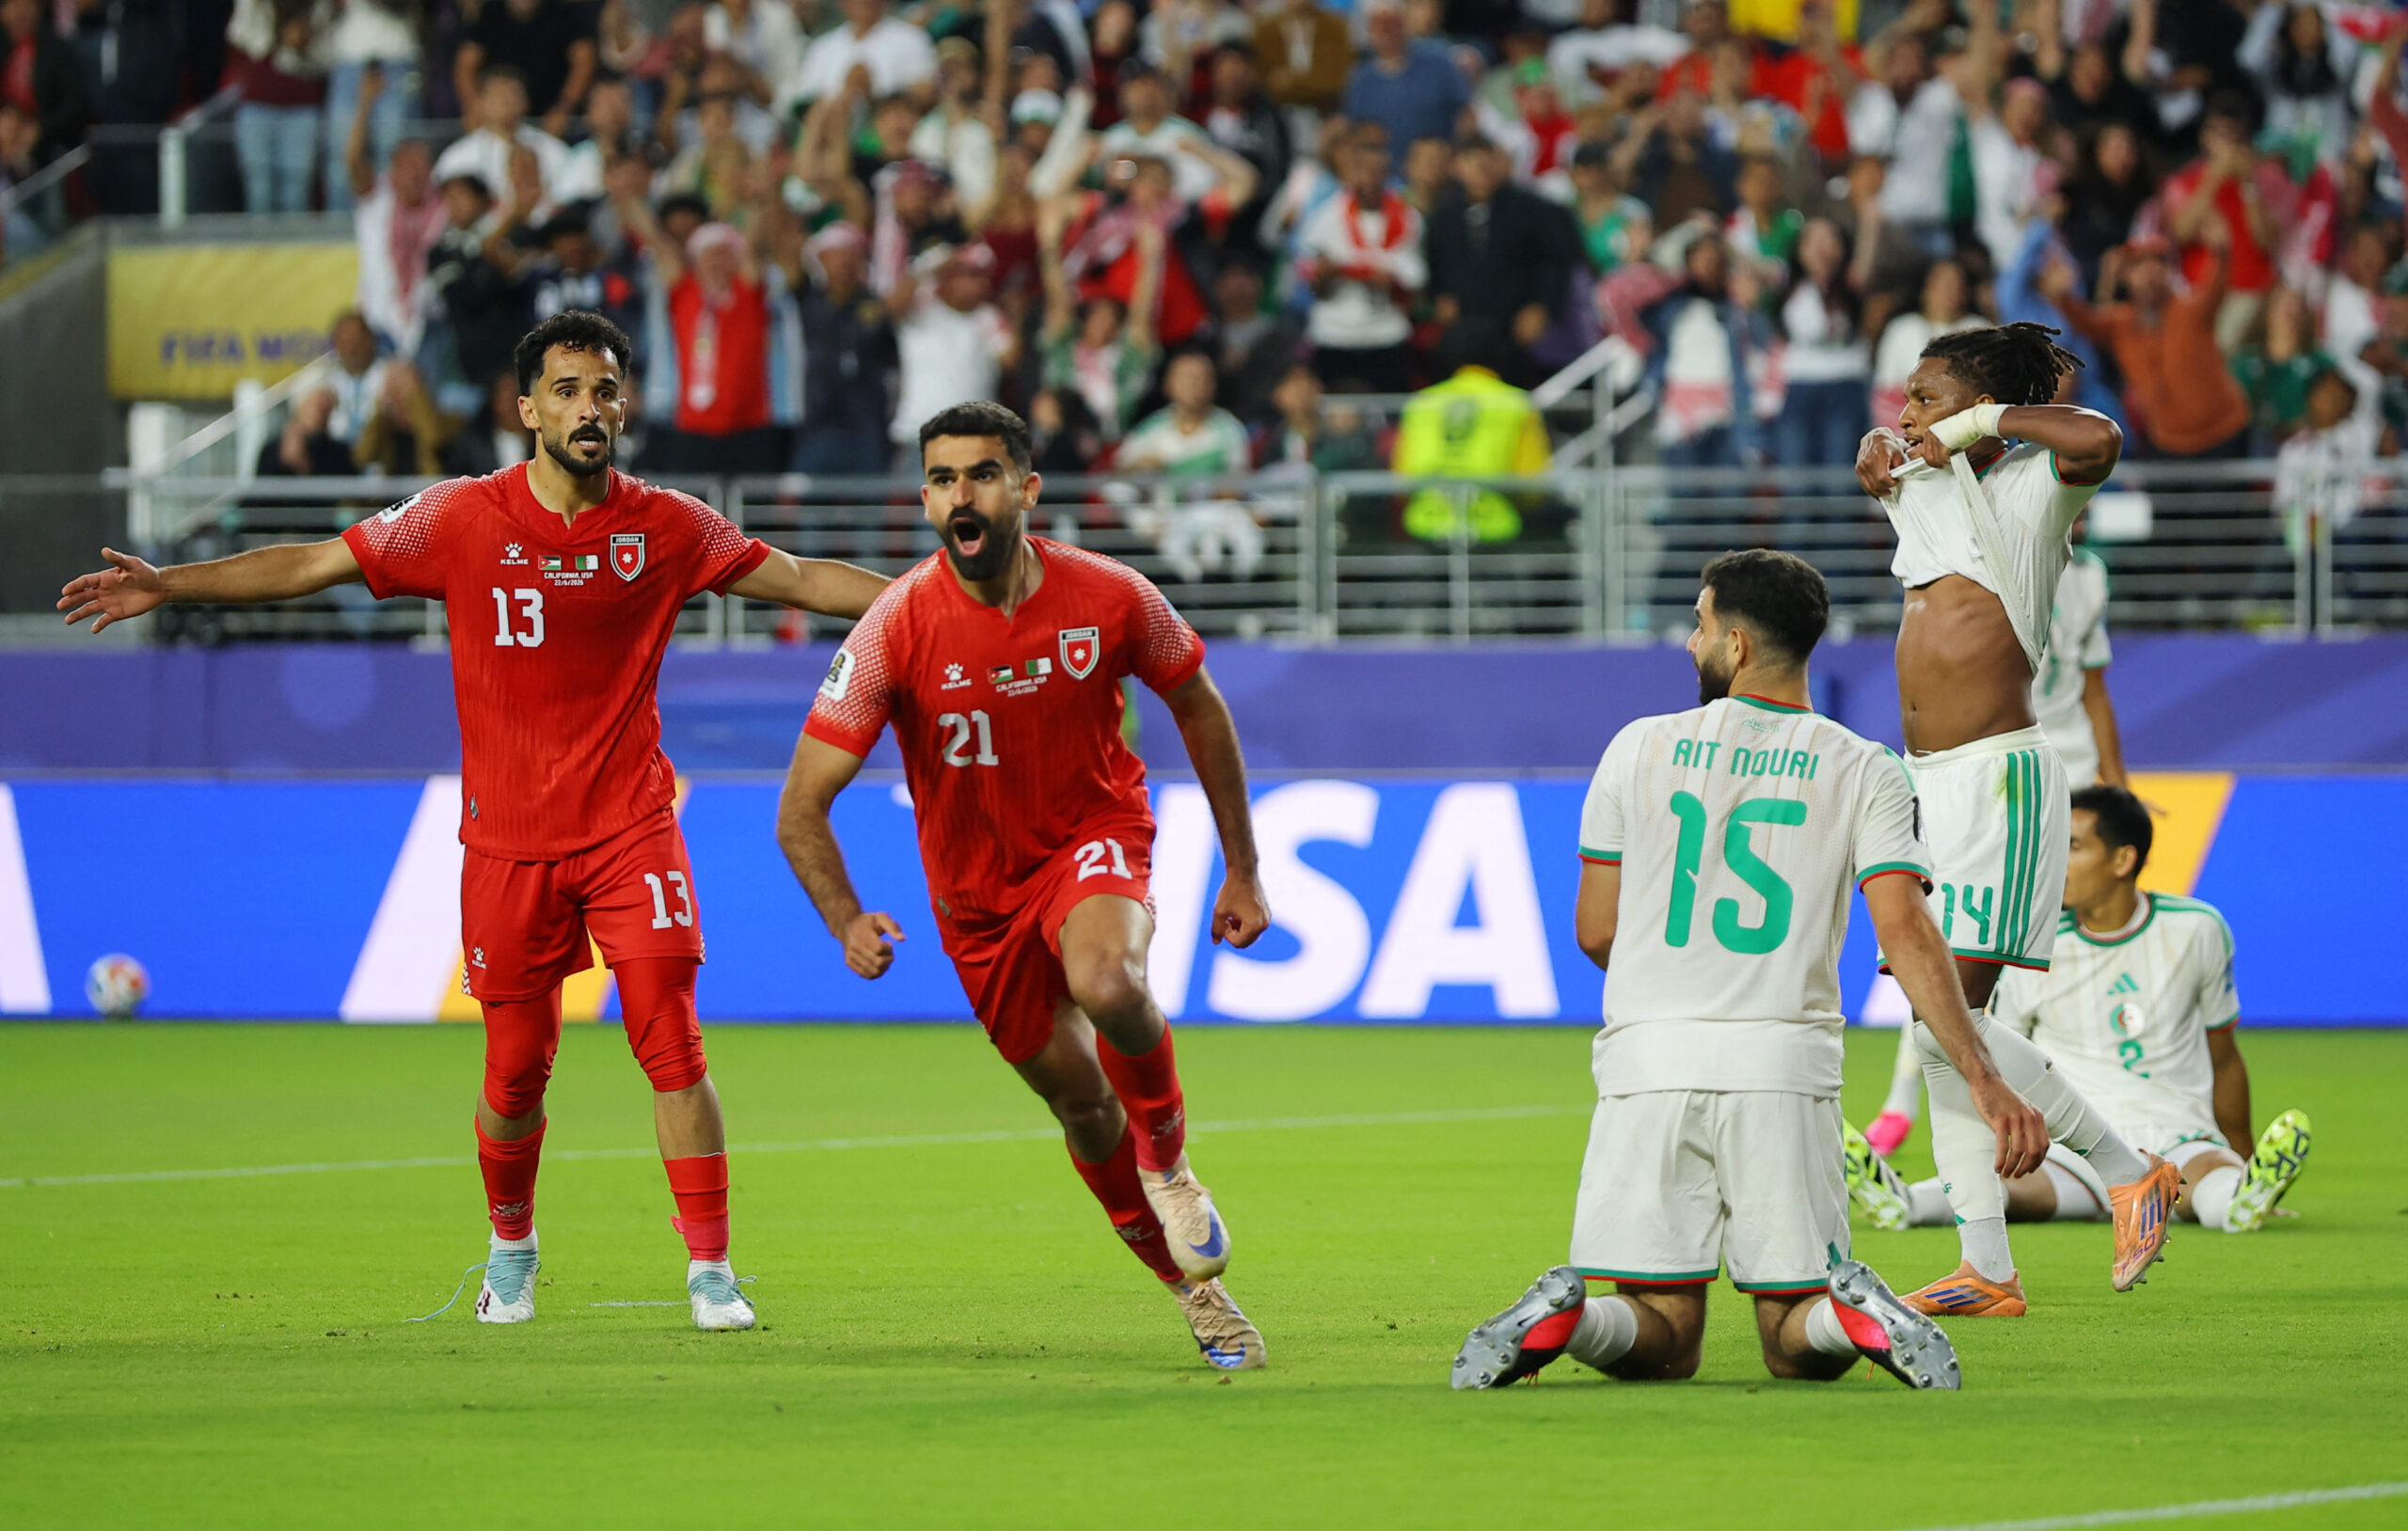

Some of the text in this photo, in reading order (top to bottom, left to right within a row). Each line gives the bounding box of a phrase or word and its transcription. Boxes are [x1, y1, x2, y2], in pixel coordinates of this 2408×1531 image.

[492, 587, 545, 648] 13
[941, 678, 973, 690] KELME
[938, 709, 999, 767] 21
[1672, 738, 1819, 781] AIT NOURI
[1073, 837, 1133, 883] 21
[1665, 790, 1808, 955] 15
[643, 870, 693, 930] 13
[892, 780, 1561, 1021] ISA
[1941, 882, 1993, 945] 14
